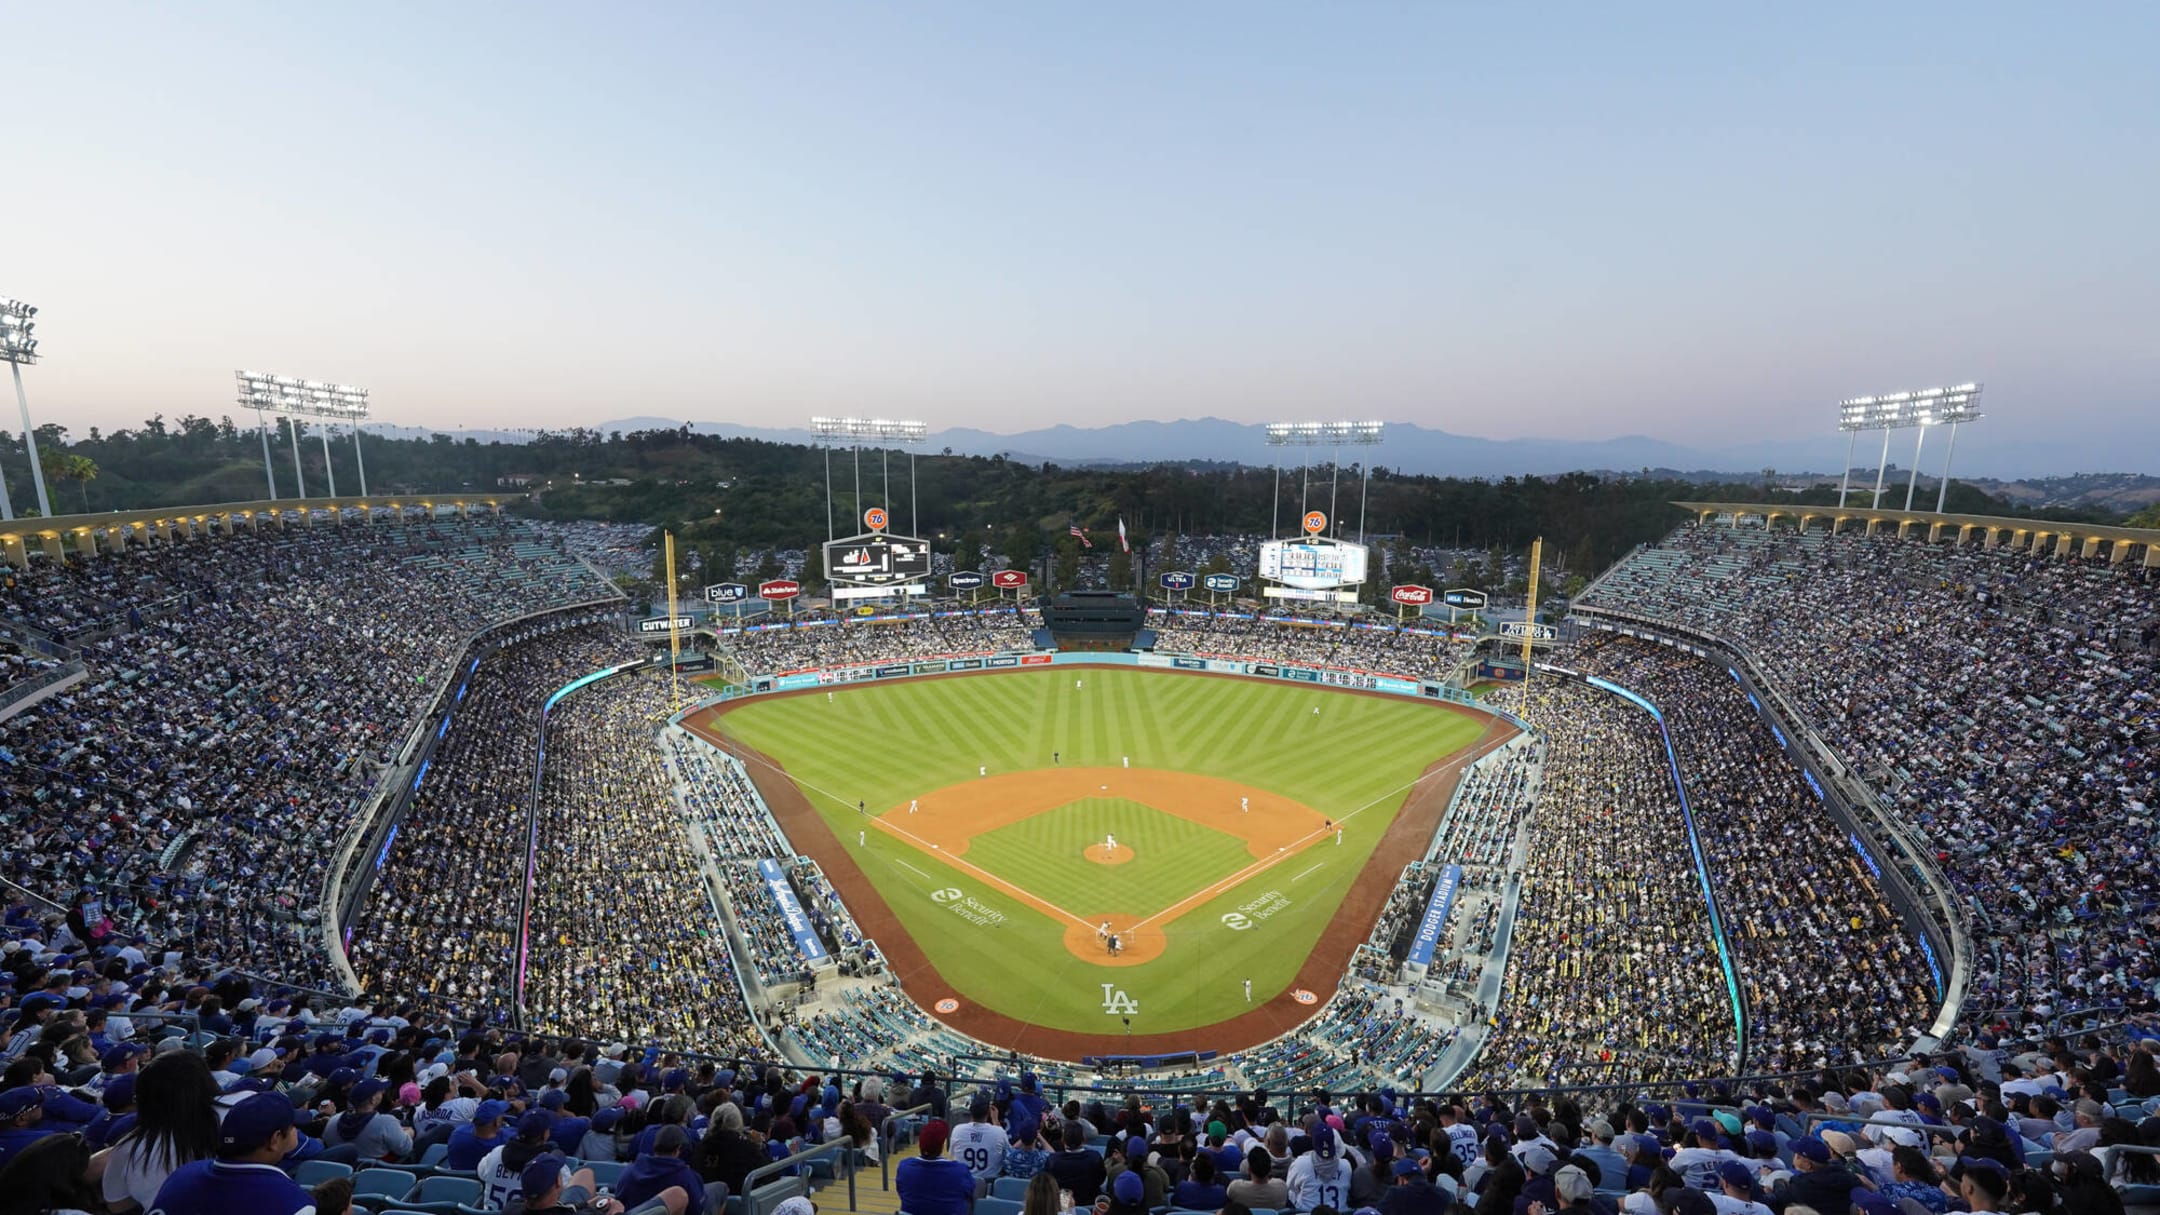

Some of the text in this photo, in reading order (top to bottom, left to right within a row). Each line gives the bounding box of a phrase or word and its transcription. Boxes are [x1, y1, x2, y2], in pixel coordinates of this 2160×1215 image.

[871, 514, 883, 524] 76
[1308, 517, 1321, 527] 76
[711, 587, 734, 597] blue
[961, 896, 1008, 923] Security
[1238, 889, 1282, 913] Security
[1253, 896, 1292, 920] Benefit
[947, 903, 988, 926] Benefit
[1420, 909, 1442, 942] DODGER
[1101, 983, 1138, 1014] LA
[417, 1109, 453, 1121] LASORDA
[964, 1148, 988, 1171] 99
[1455, 1143, 1477, 1163] 35
[1318, 1184, 1339, 1210] 13
